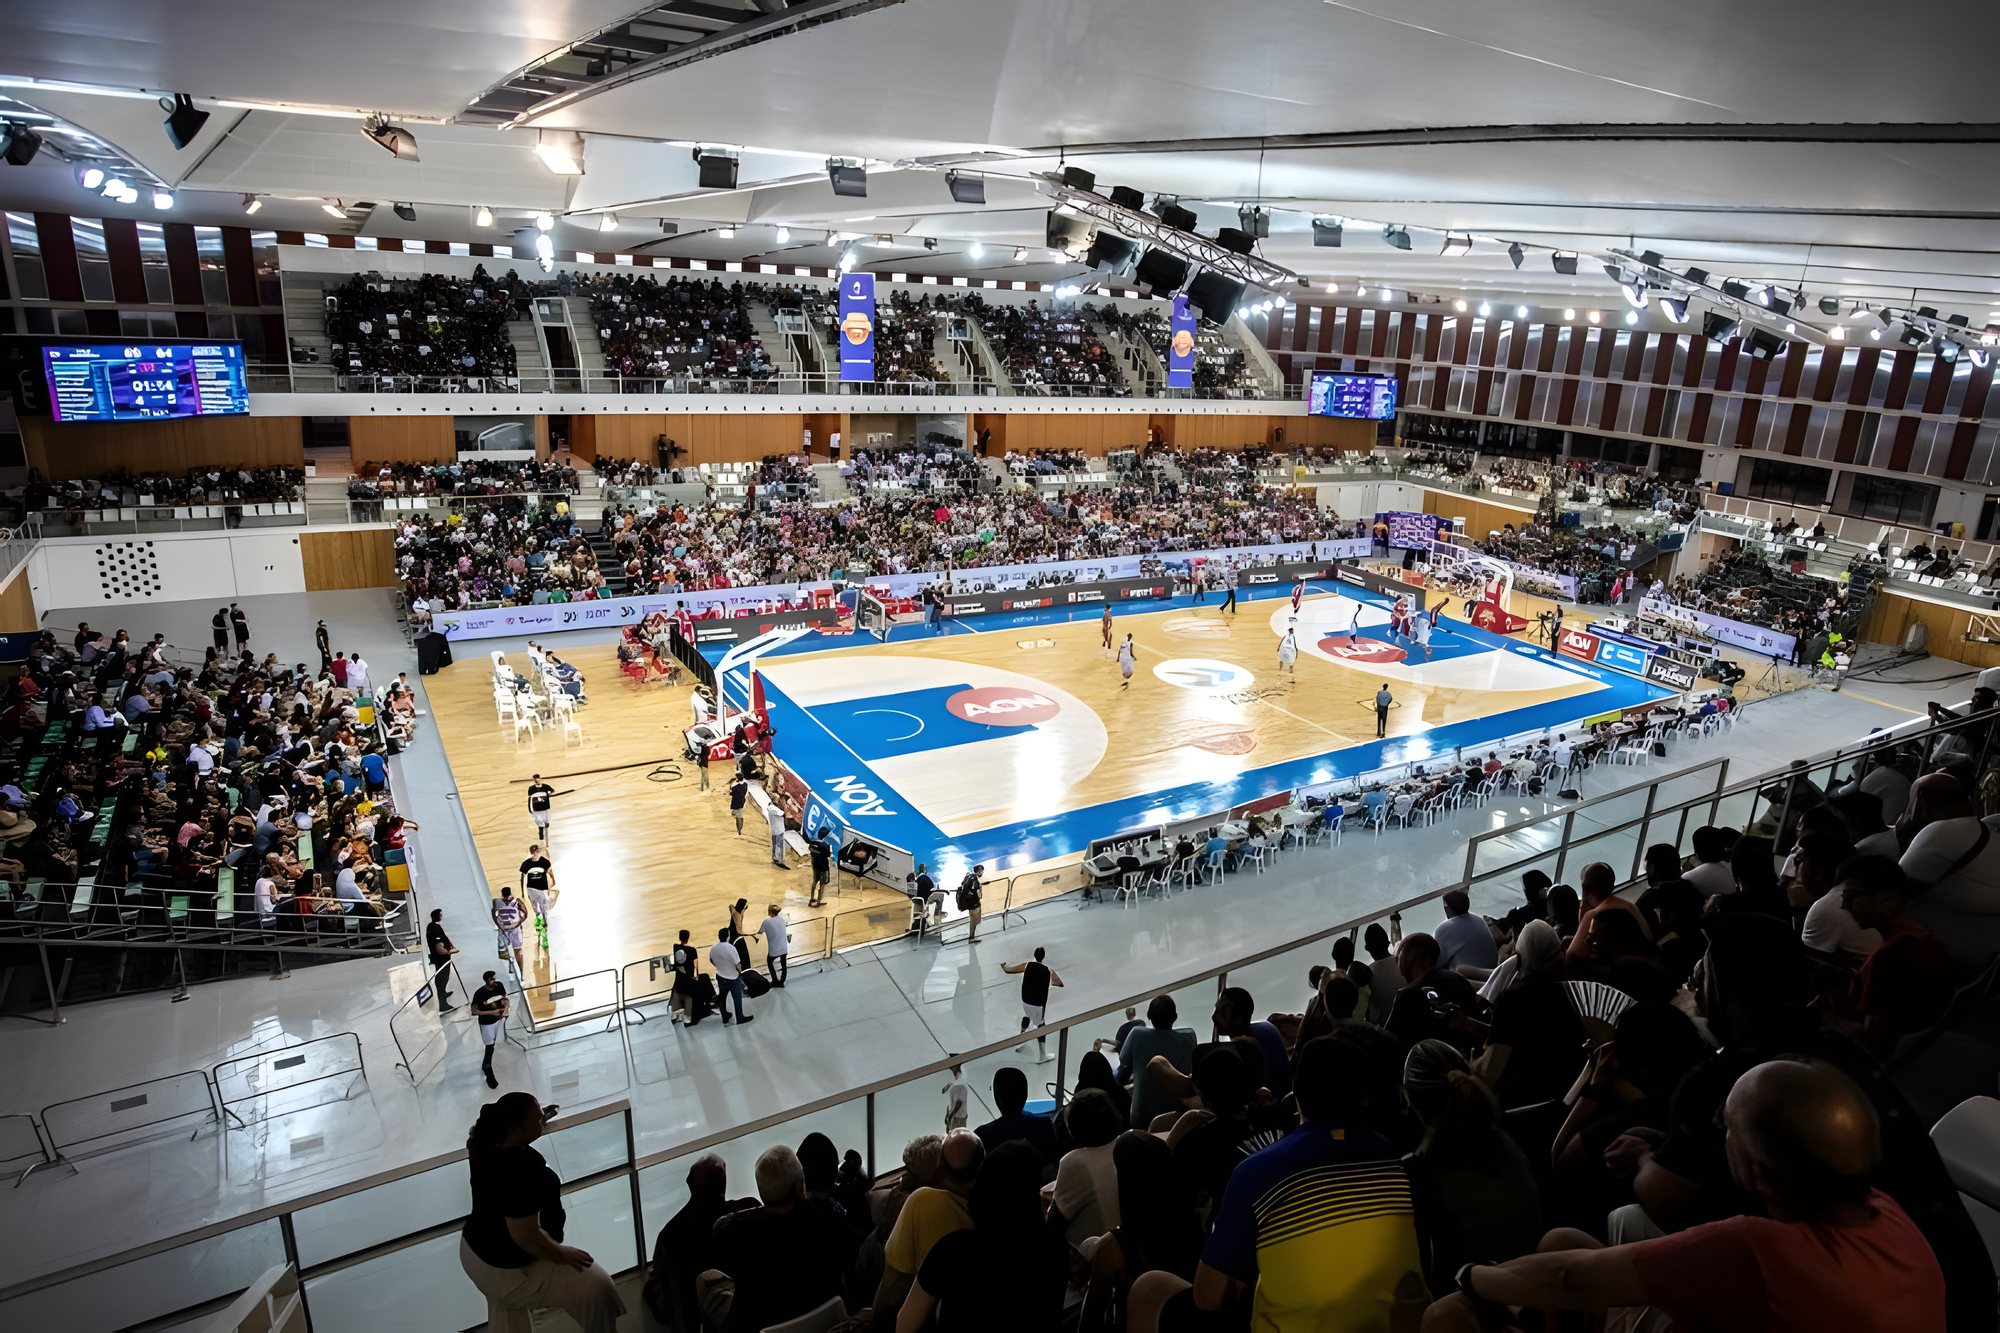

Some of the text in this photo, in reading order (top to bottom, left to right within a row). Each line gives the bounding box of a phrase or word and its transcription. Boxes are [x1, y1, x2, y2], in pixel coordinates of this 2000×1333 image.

[1563, 632, 1591, 649] AON
[964, 694, 1056, 717] AON
[824, 775, 897, 815] AON
